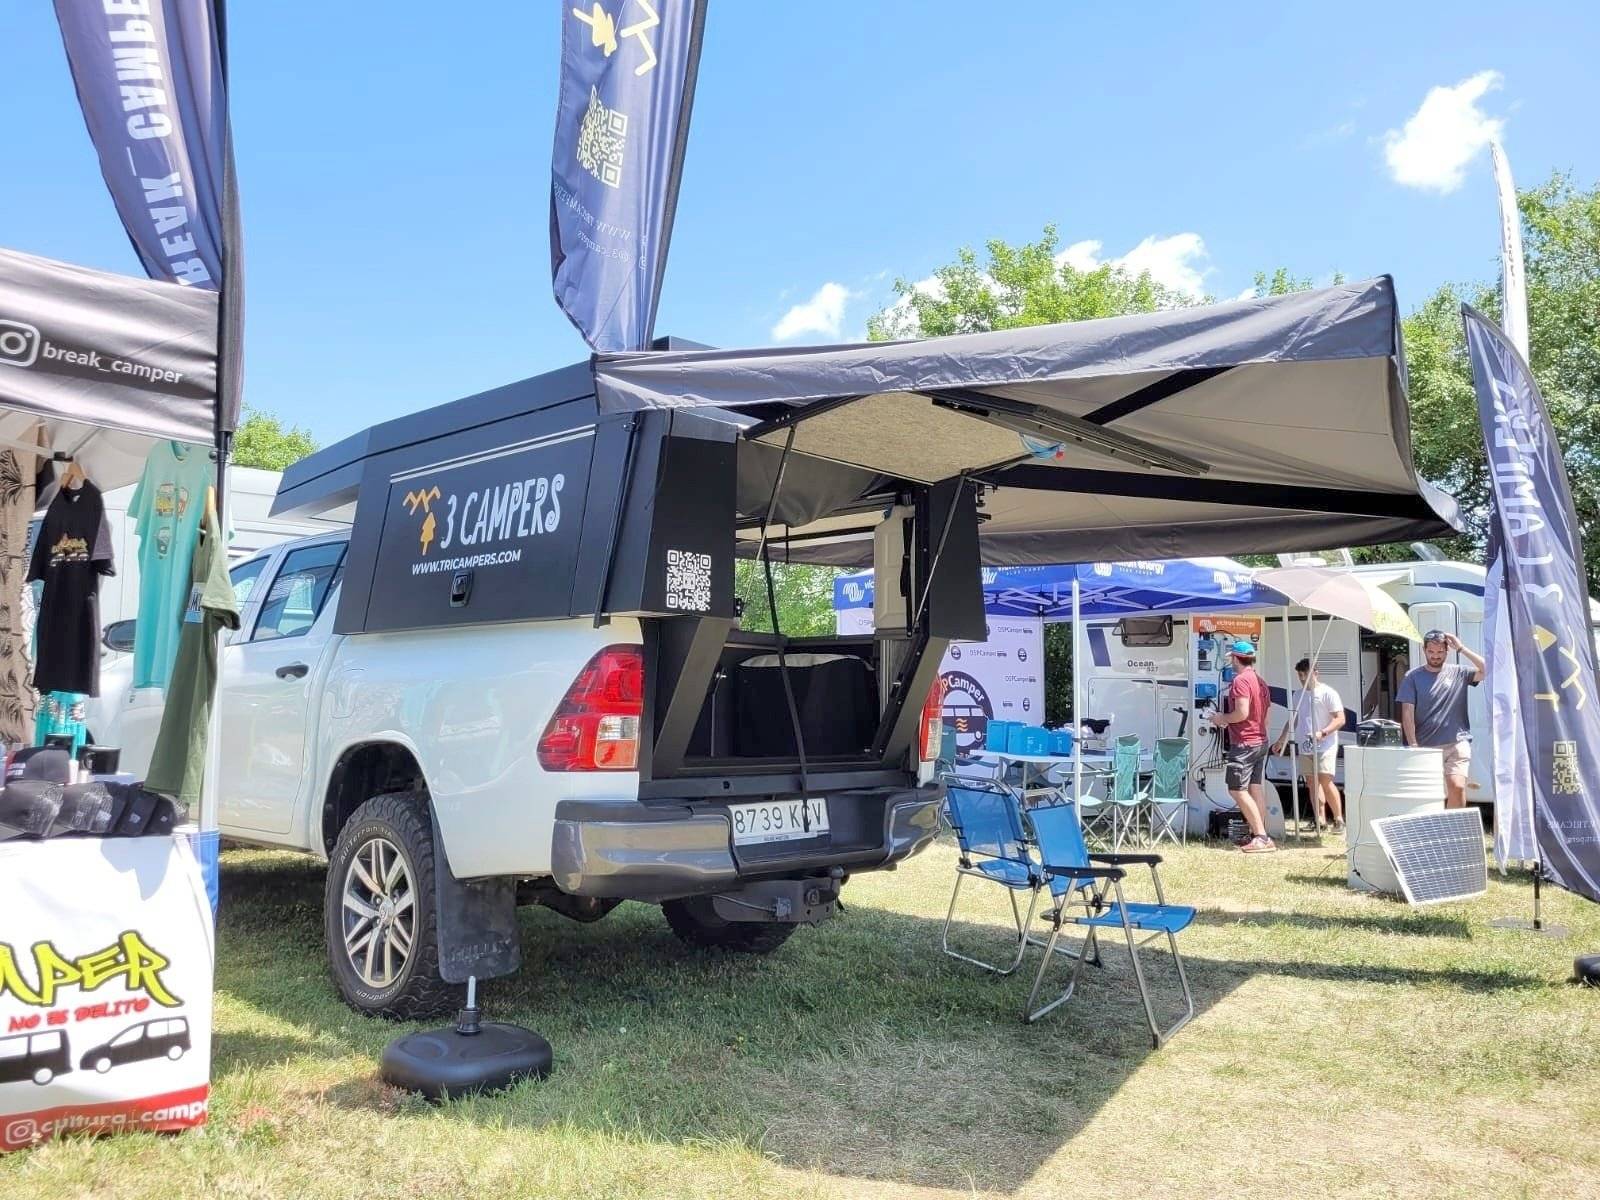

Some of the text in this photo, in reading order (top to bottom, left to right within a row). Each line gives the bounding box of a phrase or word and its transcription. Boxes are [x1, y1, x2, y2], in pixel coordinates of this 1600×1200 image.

[42, 341, 183, 384] break_camper
[440, 473, 565, 549] 3 CAMPERS
[412, 549, 521, 575] WWW.TRICAMPERS.COM
[735, 806, 783, 834] 8739
[8, 1014, 41, 1032] NO
[74, 999, 149, 1021] DELITO
